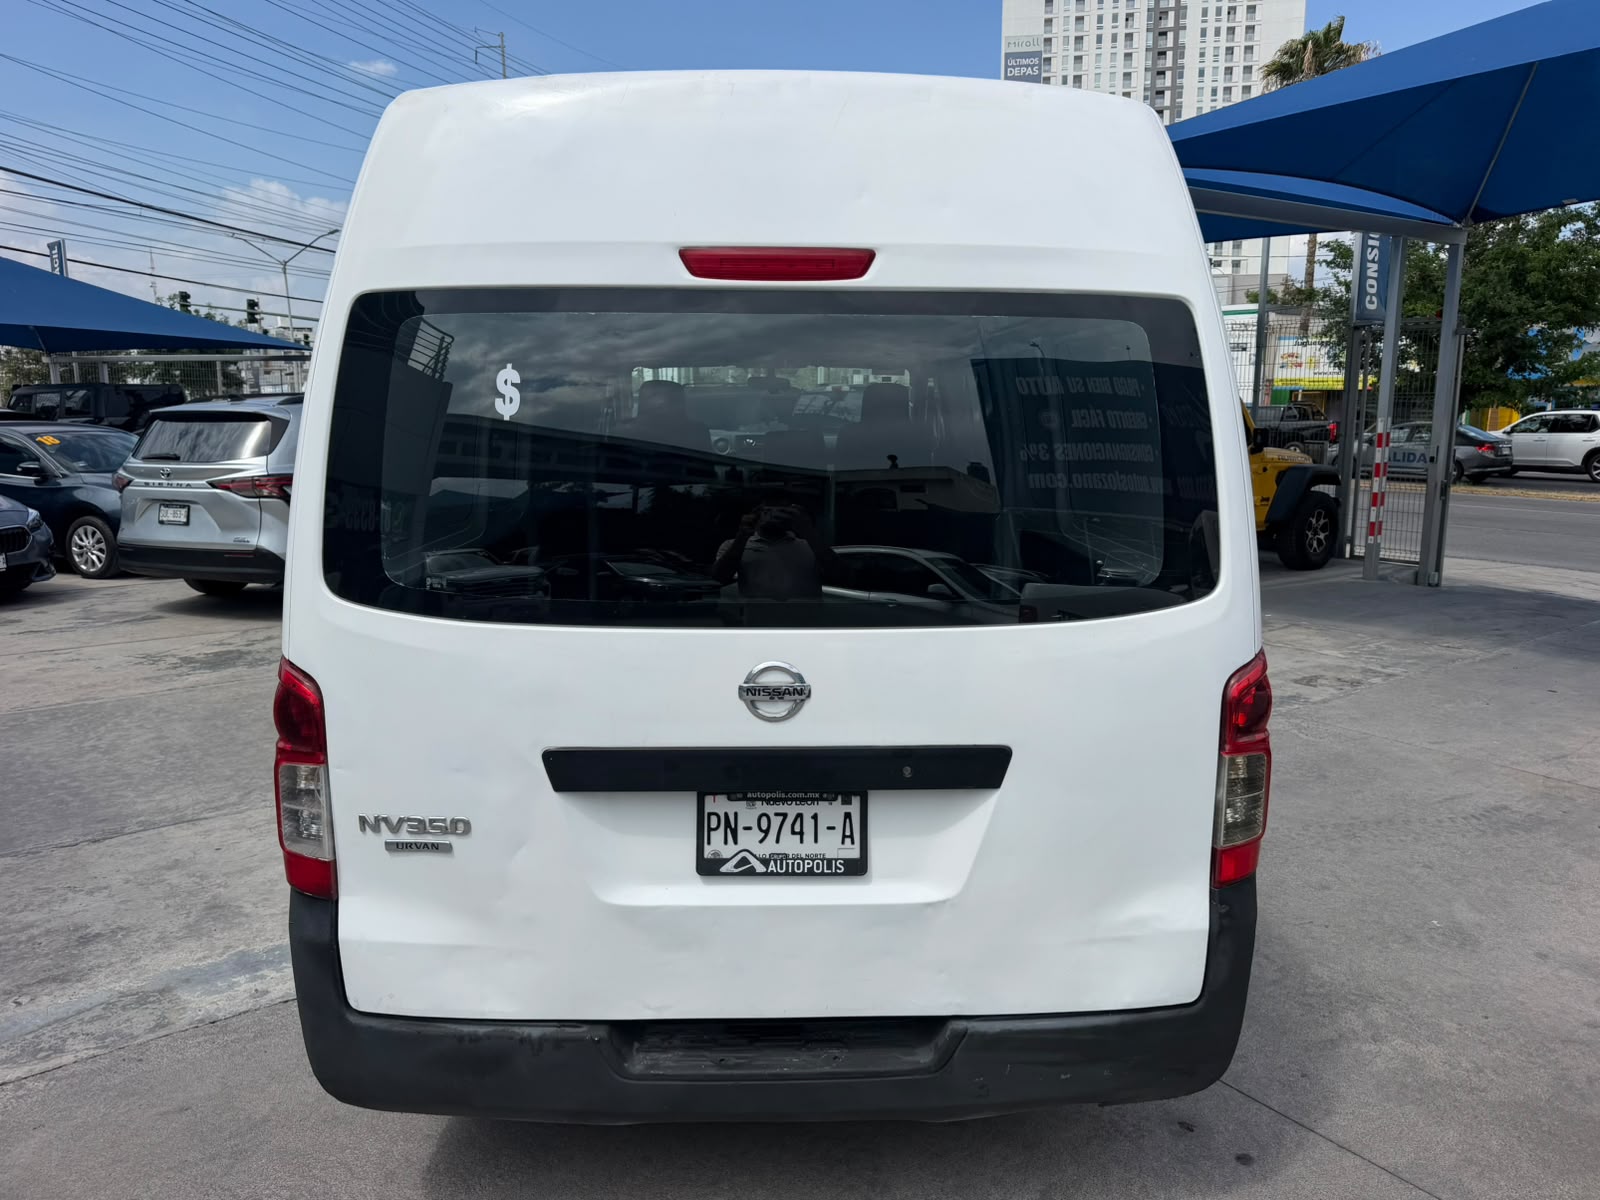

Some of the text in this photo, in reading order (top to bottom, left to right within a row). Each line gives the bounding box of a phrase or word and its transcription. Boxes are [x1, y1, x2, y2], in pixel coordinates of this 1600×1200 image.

[1007, 66, 1039, 77] DEPAS
[495, 363, 520, 421] $
[745, 687, 804, 697] NISSAN
[747, 790, 820, 799] autopolis.com.mx
[358, 813, 472, 836] NV350
[706, 811, 855, 846] PN-9741-A
[396, 842, 440, 850] URVAN
[768, 859, 845, 873] AUTOPOLIS
